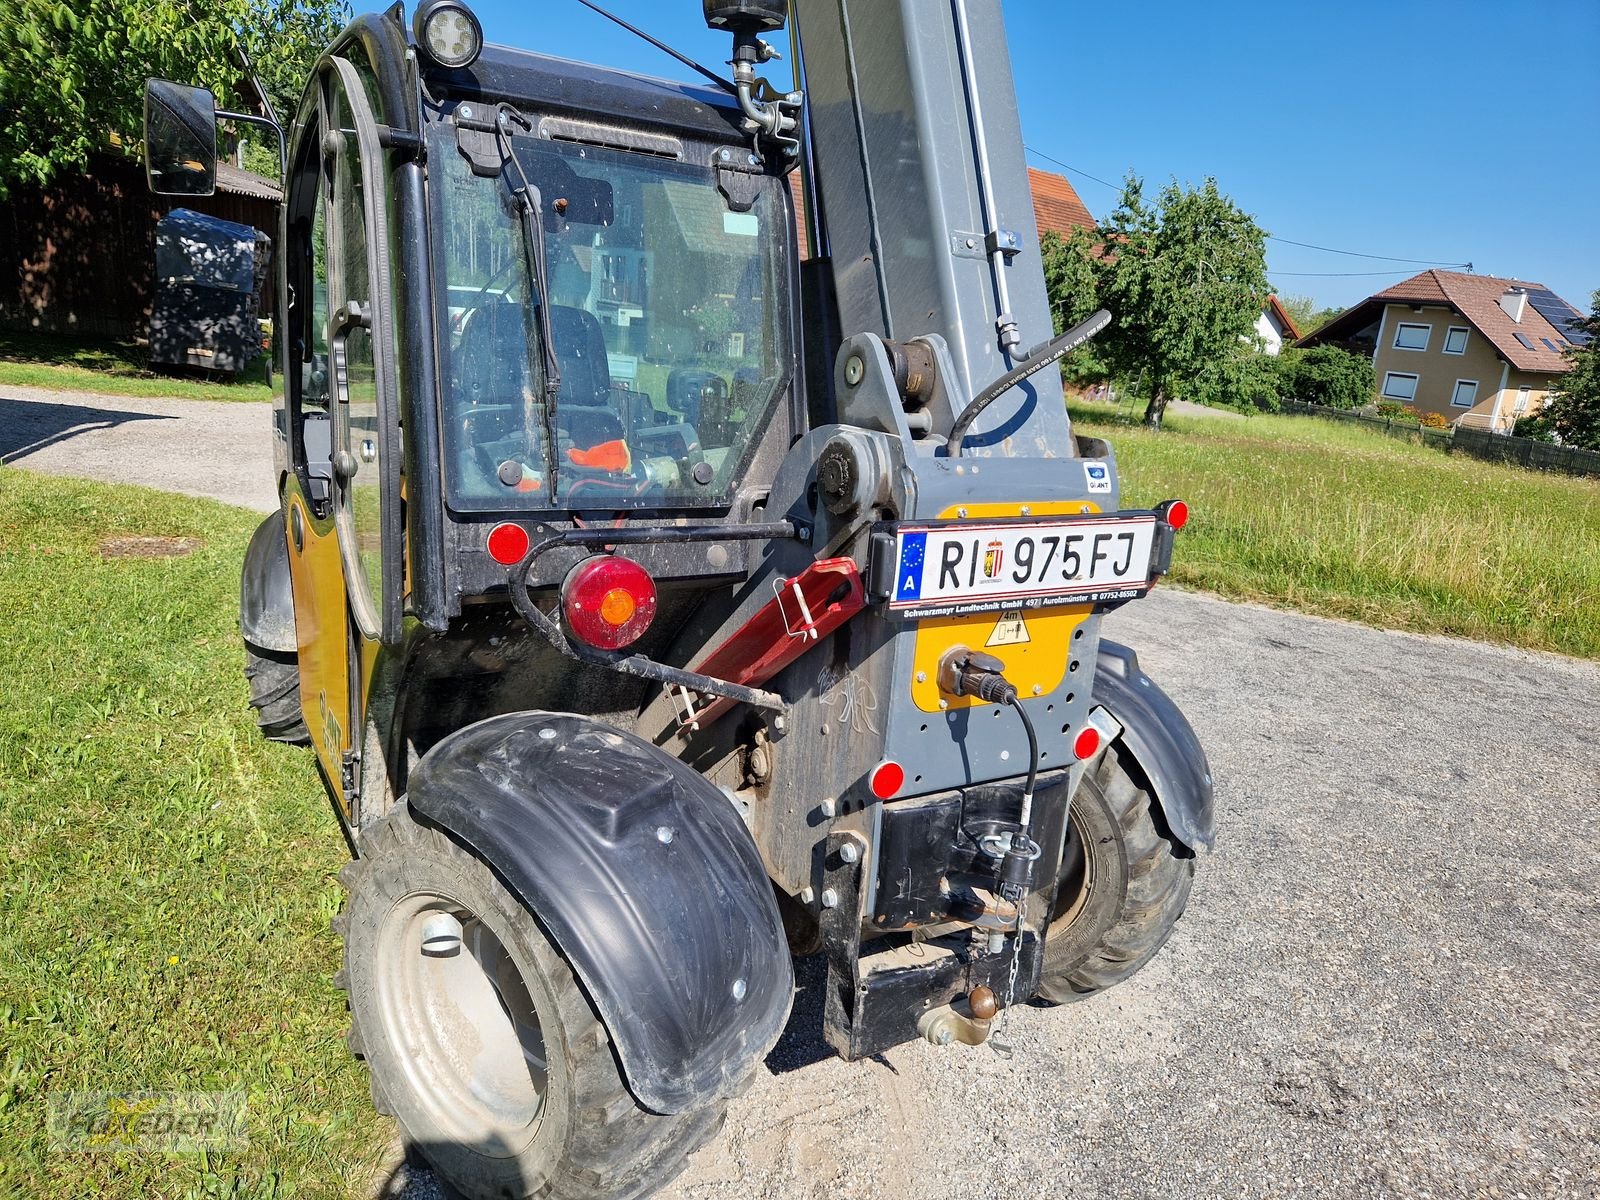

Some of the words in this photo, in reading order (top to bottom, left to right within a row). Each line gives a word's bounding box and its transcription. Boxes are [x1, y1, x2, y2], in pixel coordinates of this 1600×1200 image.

[1053, 349, 1065, 359] WP
[1040, 356, 1052, 366] 160
[1026, 363, 1041, 374] BAR
[903, 575, 915, 591] A
[939, 539, 979, 589] RI
[903, 607, 954, 618] Schwarzmayr
[955, 602, 1000, 613] Landtechnik
[1001, 600, 1023, 609] GmbH
[1042, 595, 1088, 605] Aurolzmünster
[1099, 589, 1138, 600] 07752-86502
[1004, 611, 1018, 620] 4m
